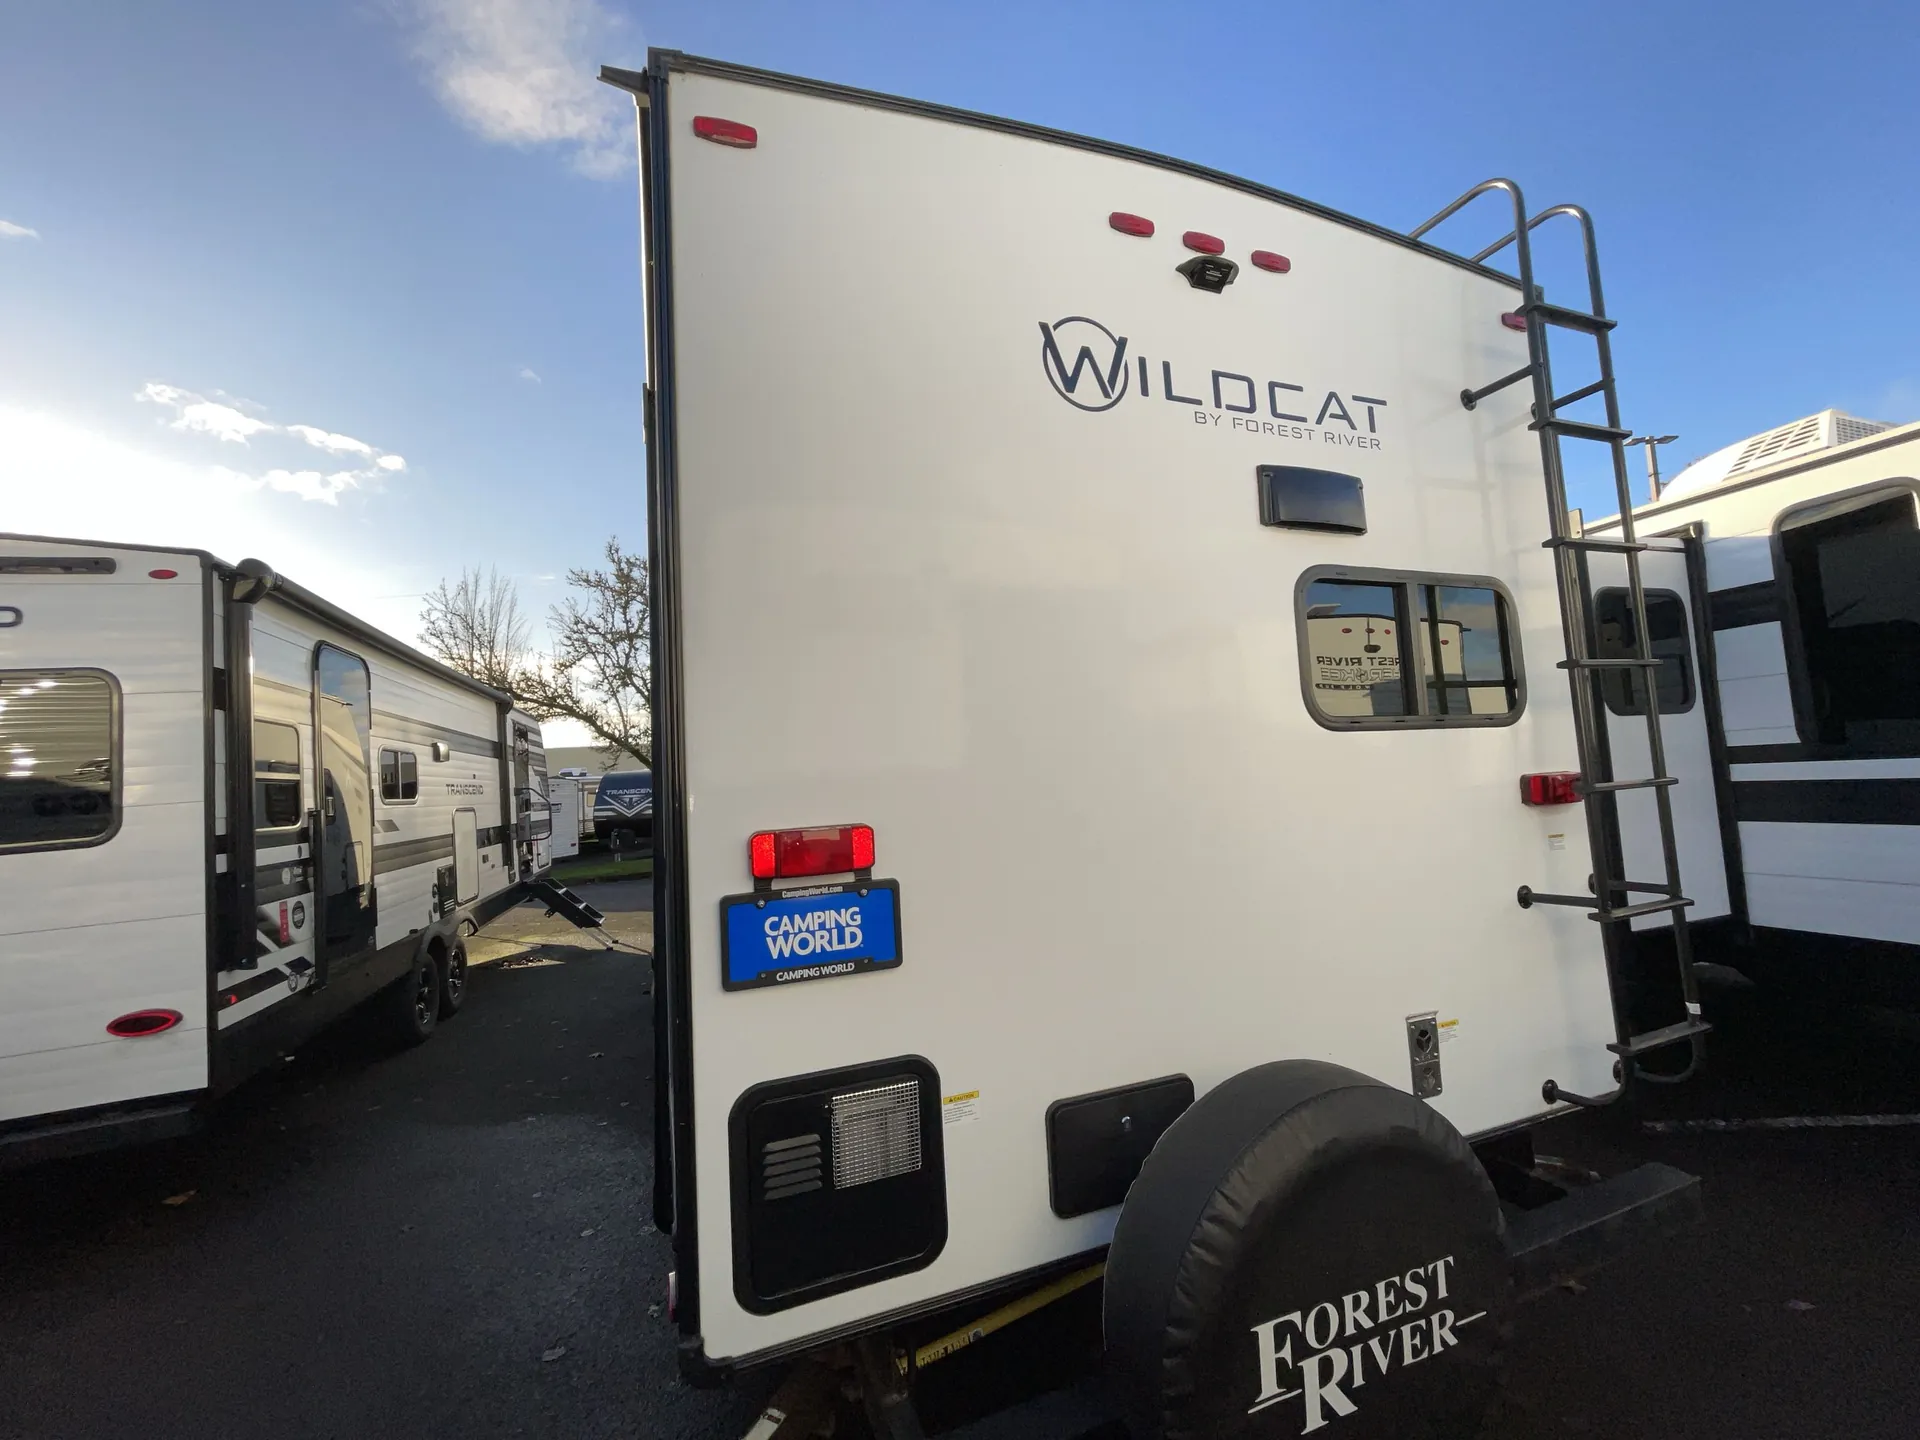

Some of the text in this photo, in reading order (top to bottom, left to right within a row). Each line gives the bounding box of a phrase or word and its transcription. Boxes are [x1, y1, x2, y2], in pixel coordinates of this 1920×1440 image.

[1038, 316, 1387, 433] WILDCAT
[1194, 410, 1383, 451] BY FOREST RIVER
[446, 783, 484, 796] TRANSCEND
[782, 886, 843, 899] CampingWorld.com
[764, 906, 862, 936] CAMPING
[765, 926, 863, 960] WORLD
[776, 962, 855, 982] CAMPING WORLD
[1250, 1255, 1454, 1403] FOREST
[1297, 1309, 1459, 1436] RIVER
